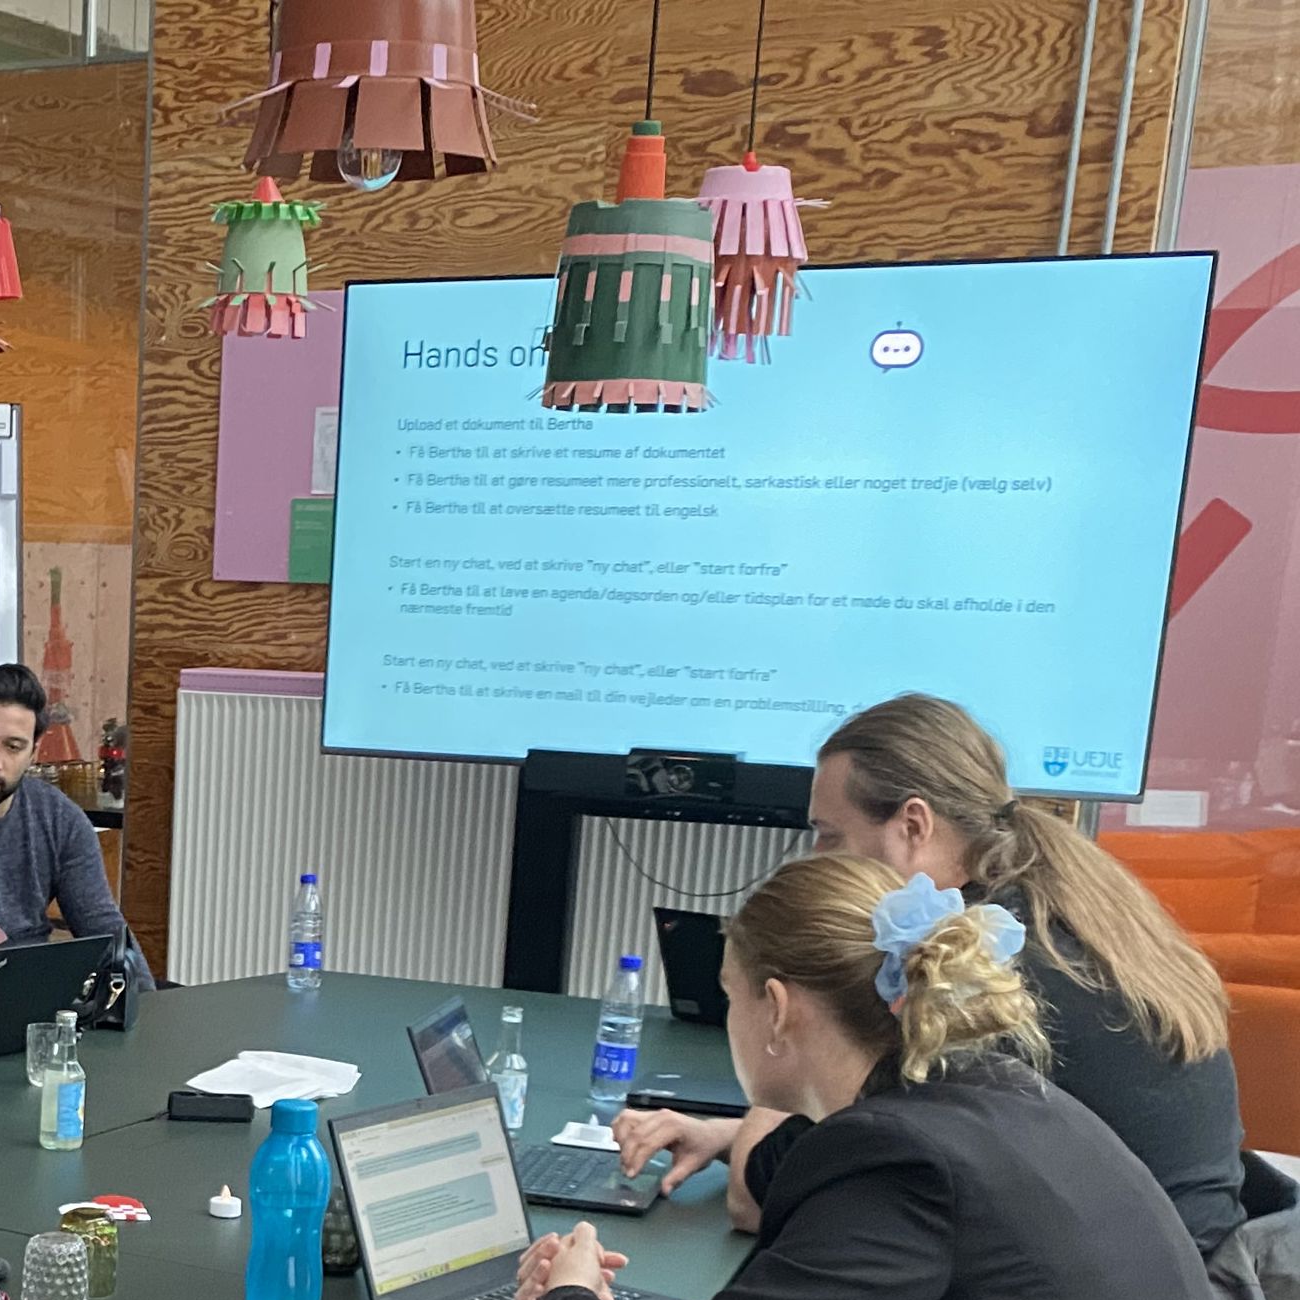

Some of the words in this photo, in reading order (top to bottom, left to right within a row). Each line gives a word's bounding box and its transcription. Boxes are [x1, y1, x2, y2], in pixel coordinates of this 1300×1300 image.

[403, 339, 499, 369] Hands
[509, 345, 546, 367] on
[397, 418, 442, 433] Upload
[445, 419, 458, 431] et
[462, 418, 525, 431] dokument
[529, 417, 544, 430] til
[548, 417, 594, 431] Bertha
[409, 445, 425, 458] Få
[429, 446, 472, 459] Bertha
[475, 446, 489, 459] til
[492, 447, 506, 459] at
[510, 446, 552, 459] skrive
[555, 448, 570, 459] et
[572, 448, 622, 459] resume
[625, 446, 640, 459] af
[642, 446, 726, 459] dokumentet
[407, 473, 424, 487] Få
[427, 474, 470, 487] Bertha
[473, 474, 488, 487] til
[491, 475, 505, 487] at
[508, 476, 539, 490] gøre
[542, 475, 604, 488] resumeet
[607, 477, 641, 488] mere
[643, 475, 741, 490] professionelt,
[745, 475, 821, 489] sarkastisk
[824, 475, 860, 489] eller
[863, 476, 907, 492] noget
[911, 476, 958, 493] tredje
[961, 476, 1007, 493] (vælg
[1011, 476, 1053, 493] selv)
[405, 500, 421, 514] Få
[425, 501, 467, 514] Bertha
[470, 502, 486, 515] til
[489, 503, 503, 515] at
[506, 503, 575, 516] oversætte
[578, 503, 641, 517] resumeet
[644, 504, 661, 516] til
[663, 504, 718, 520] engelsk
[389, 555, 421, 569] Start
[424, 558, 441, 569] en
[443, 558, 459, 573] ny
[462, 557, 495, 571] chat,
[498, 558, 522, 571] ved
[525, 559, 539, 571] at
[541, 558, 583, 572] skrive
[657, 562, 690, 575] eller
[400, 583, 416, 596] Få
[420, 584, 463, 598] Bertha
[466, 585, 480, 598] til
[483, 586, 497, 598] at
[500, 586, 530, 599] lave
[532, 588, 548, 599] en
[551, 586, 679, 604] agenda/dagsorden
[682, 590, 741, 607] og/eller
[744, 592, 804, 608] tidsplan
[807, 592, 829, 607] for
[832, 595, 848, 607] et
[851, 595, 891, 609] møde
[894, 596, 913, 610] du
[916, 597, 950, 611] skal
[953, 598, 1013, 613] afholde
[1026, 600, 1056, 614] den
[399, 602, 463, 616] nærmeste
[465, 603, 513, 617] fremtid
[382, 654, 416, 667] Start
[418, 657, 435, 668] en
[436, 658, 452, 671] ny
[455, 658, 488, 671] chat,
[491, 659, 514, 671] ved
[516, 660, 531, 672] at
[534, 660, 576, 673] skrive
[647, 665, 681, 678] eller
[394, 681, 411, 694] Få
[413, 682, 456, 696] Bertha
[459, 684, 473, 697] til
[476, 686, 490, 698] at
[492, 685, 533, 699] skrive
[536, 688, 552, 700] en
[555, 688, 583, 702] mail
[586, 688, 601, 702] til
[604, 689, 626, 703] din
[630, 691, 687, 707] vejleder
[690, 697, 711, 708] om
[714, 699, 731, 709] en
[735, 697, 849, 717] problemstilling,
